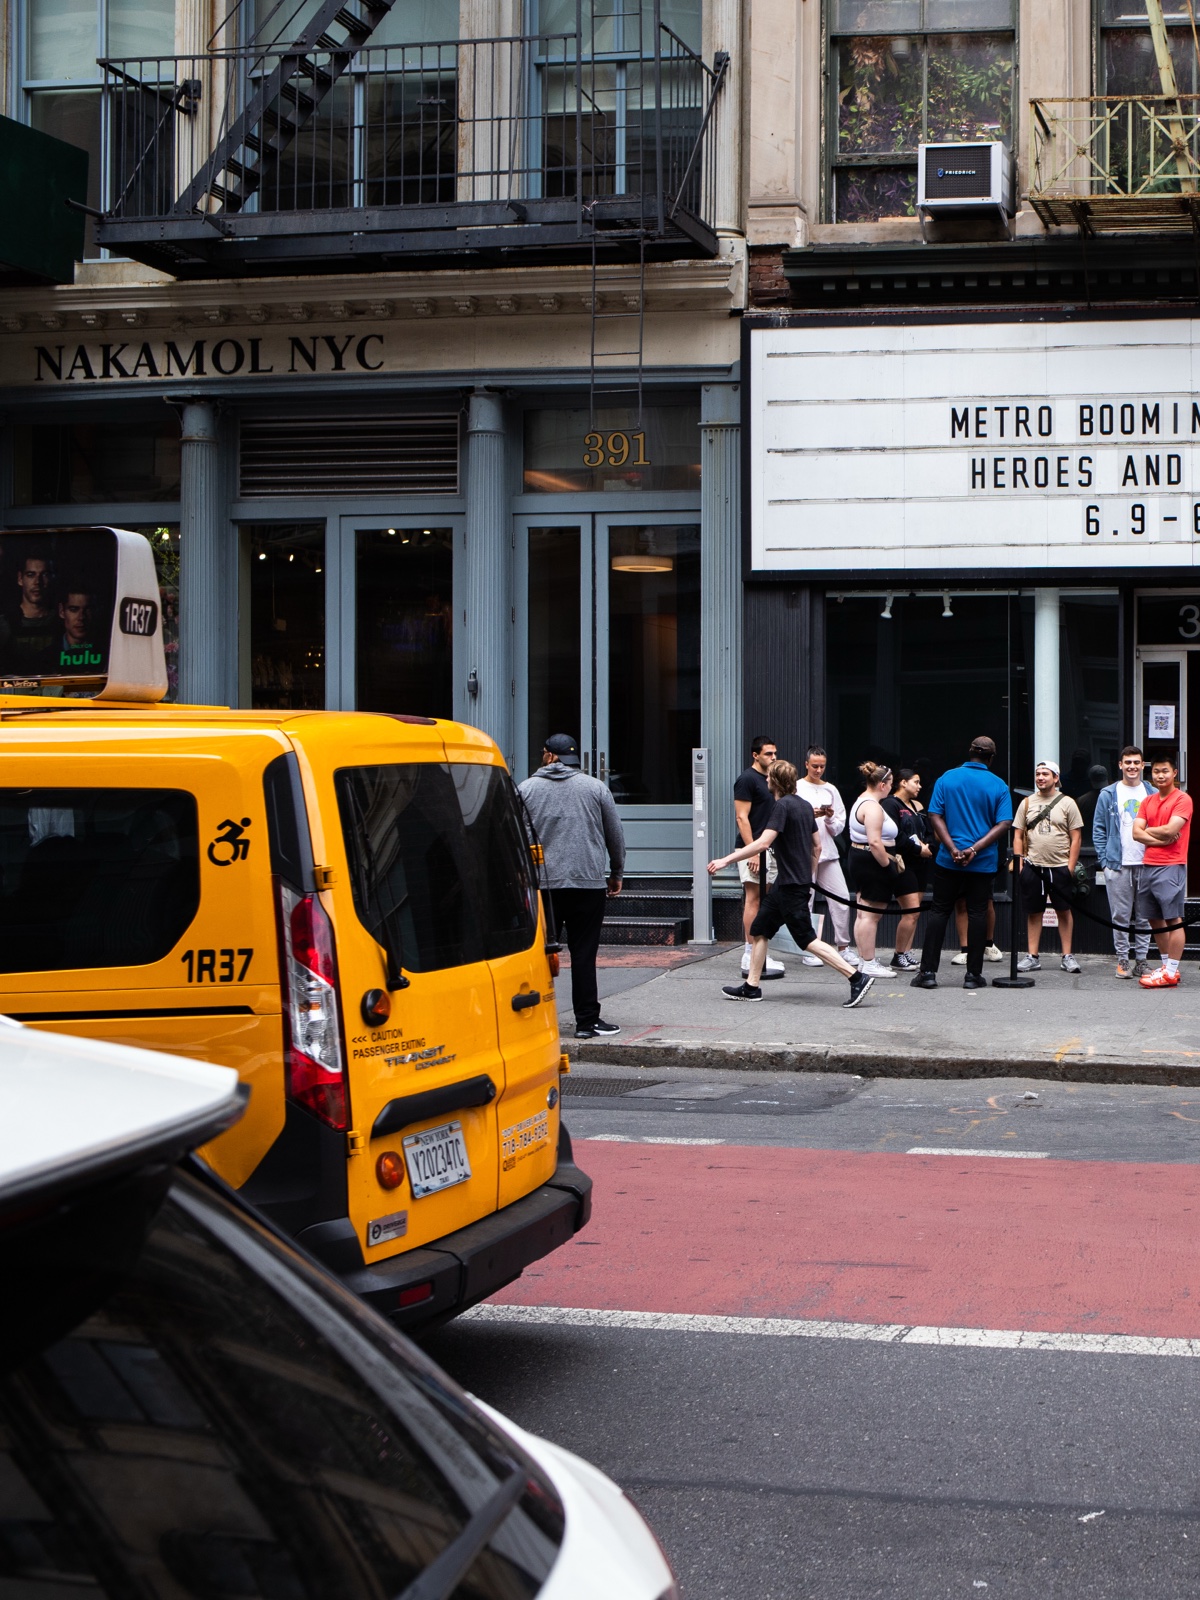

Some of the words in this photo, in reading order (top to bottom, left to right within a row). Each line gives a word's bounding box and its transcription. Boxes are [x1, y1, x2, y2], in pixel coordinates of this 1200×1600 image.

[35, 337, 274, 382] NAKAMOL
[288, 334, 385, 373] NYC
[951, 405, 1053, 439] METRO
[582, 431, 651, 468] 391
[970, 455, 1094, 490] HEROES
[1121, 453, 1183, 487] AND
[125, 602, 153, 634] 1R37
[60, 650, 102, 666] hulu
[180, 947, 254, 984] 1R37
[353, 1042, 400, 1060] PASSENGER
[401, 1037, 426, 1052] EXITING
[371, 1028, 403, 1042] CAUTION
[384, 1044, 446, 1067] TRANSIT
[420, 1134, 435, 1146] NEW
[435, 1128, 451, 1141] YORK
[412, 1138, 465, 1182] Y202347C
